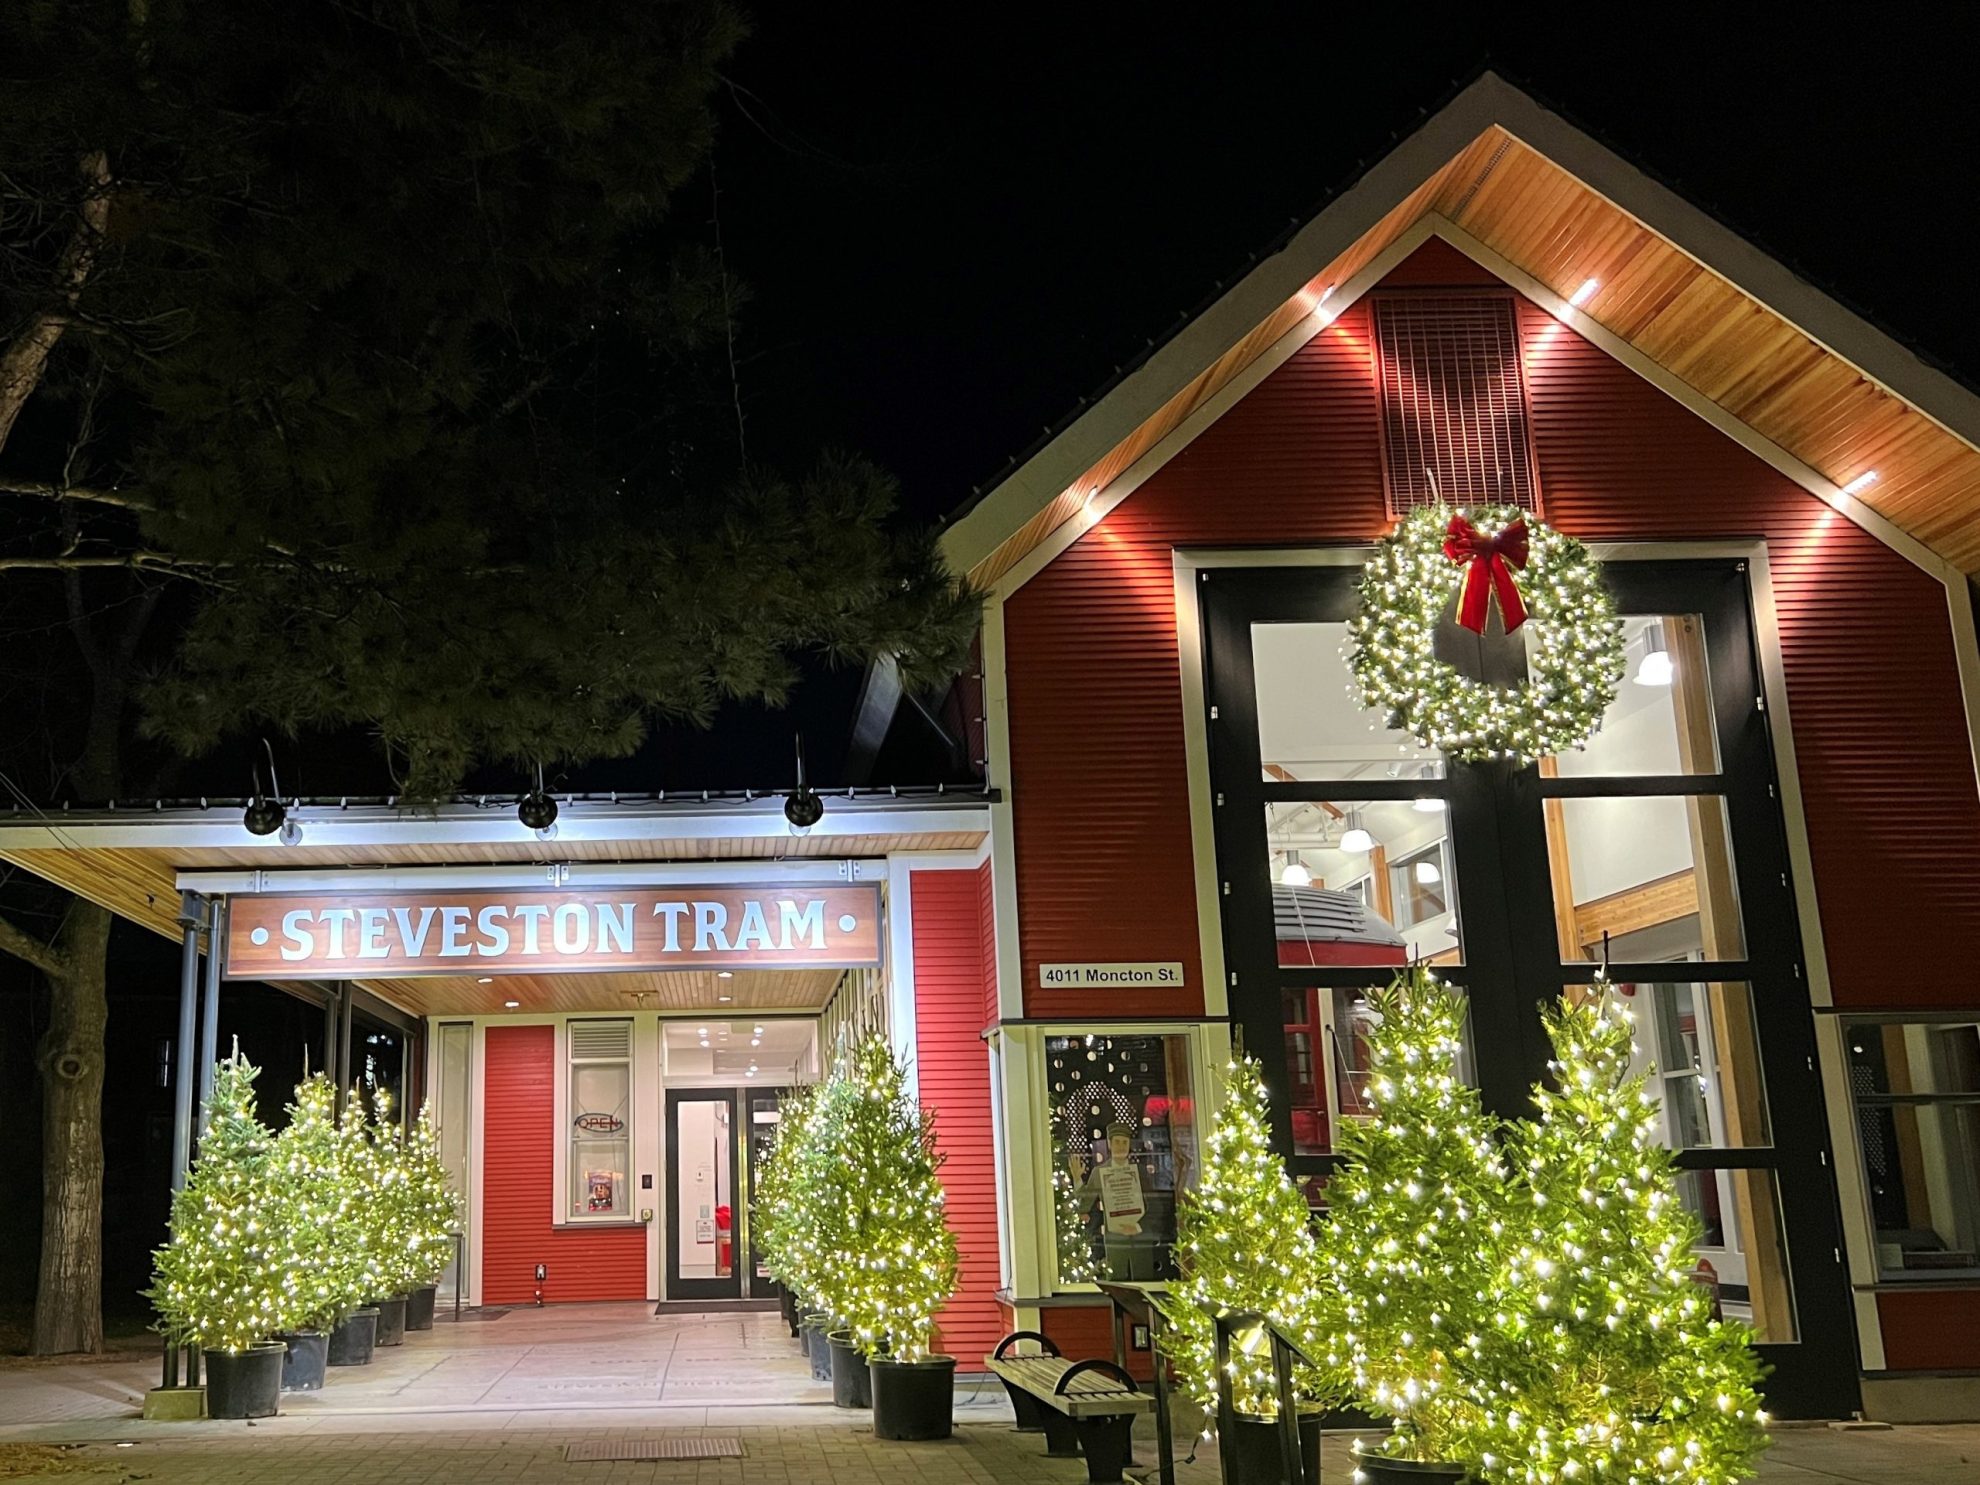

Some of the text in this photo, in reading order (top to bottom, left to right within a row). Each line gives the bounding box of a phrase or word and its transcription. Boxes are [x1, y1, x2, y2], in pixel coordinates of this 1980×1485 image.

[280, 900, 829, 961] STEVESTON TRAM
[1046, 968, 1179, 982] 4011 Moncton St.
[579, 1117, 619, 1129] OPEN
